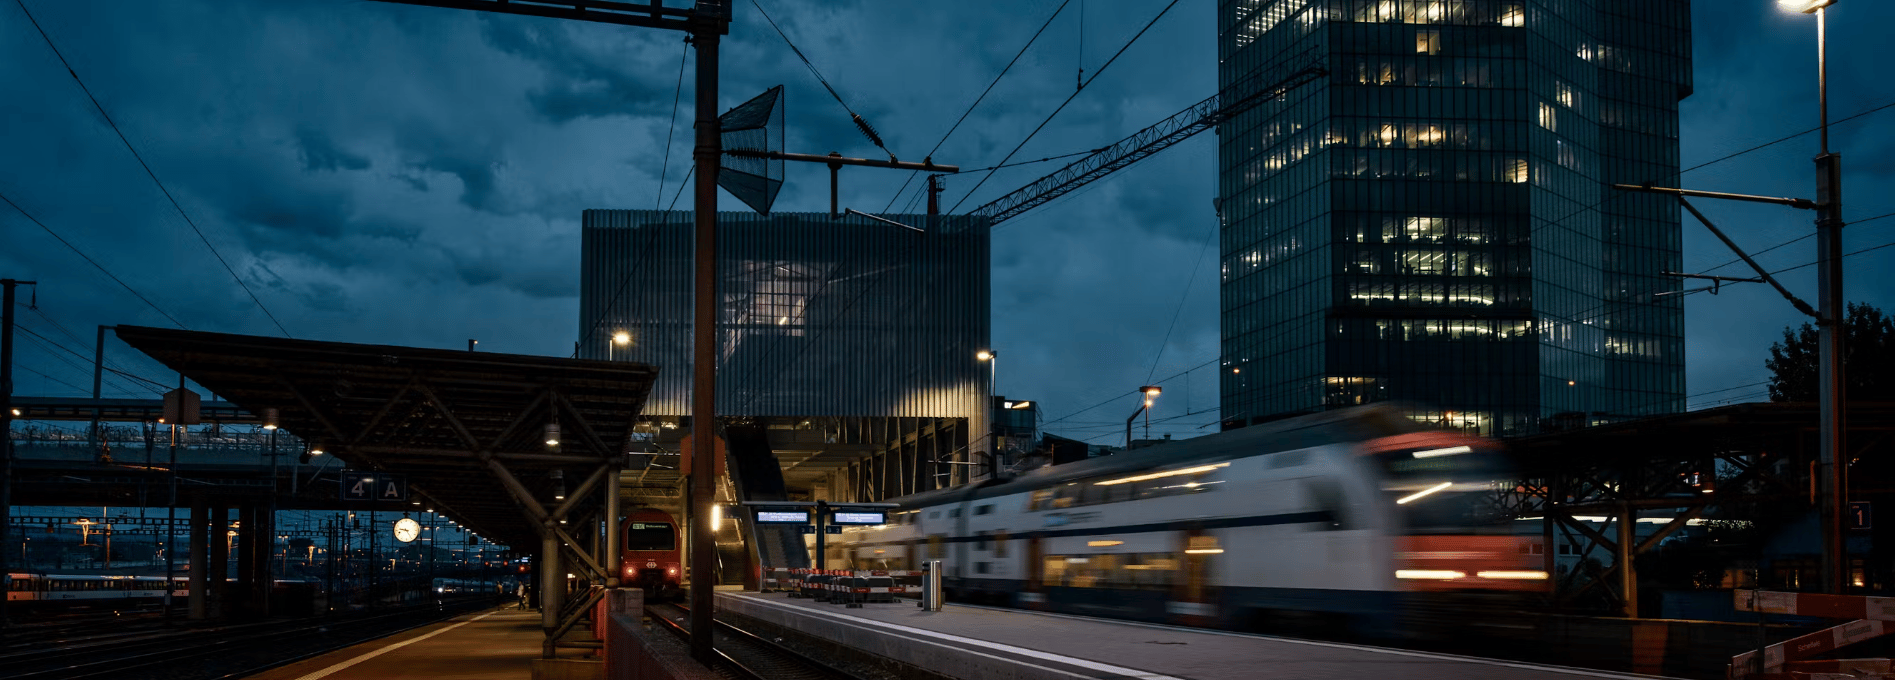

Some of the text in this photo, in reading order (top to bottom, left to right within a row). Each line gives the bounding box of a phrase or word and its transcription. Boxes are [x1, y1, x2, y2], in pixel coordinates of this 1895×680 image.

[351, 480, 365, 497] 4
[384, 481, 399, 498] A
[1856, 509, 1863, 526] 1
